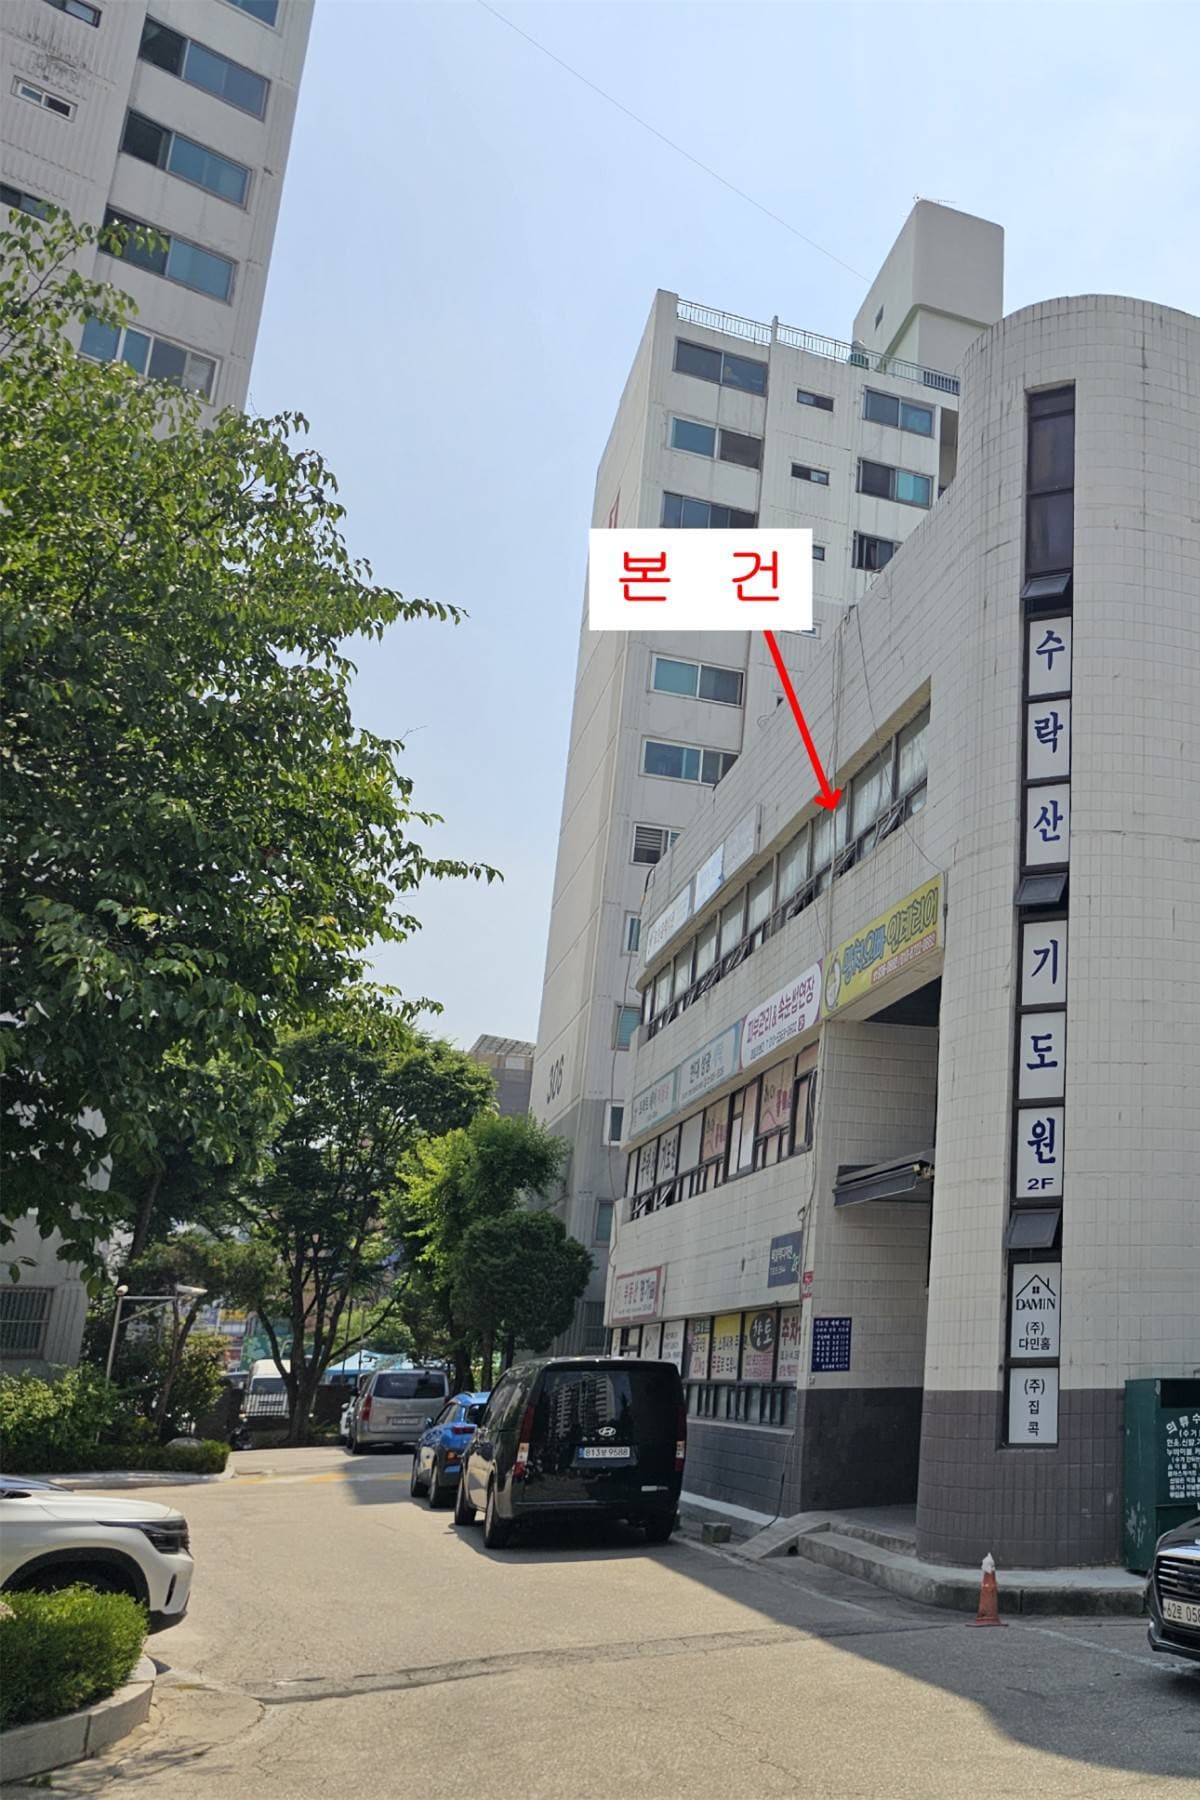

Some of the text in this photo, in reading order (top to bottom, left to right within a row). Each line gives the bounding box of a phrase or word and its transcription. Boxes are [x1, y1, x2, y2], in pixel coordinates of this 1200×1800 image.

[1033, 630, 1066, 842] 수락산
[1026, 939, 1059, 1164] 기도원
[1027, 1178, 1054, 1190] 2F
[1016, 1298, 1056, 1311] DAMIN
[1025, 1321, 1045, 1336] (주)
[1024, 1378, 1046, 1395] (주)
